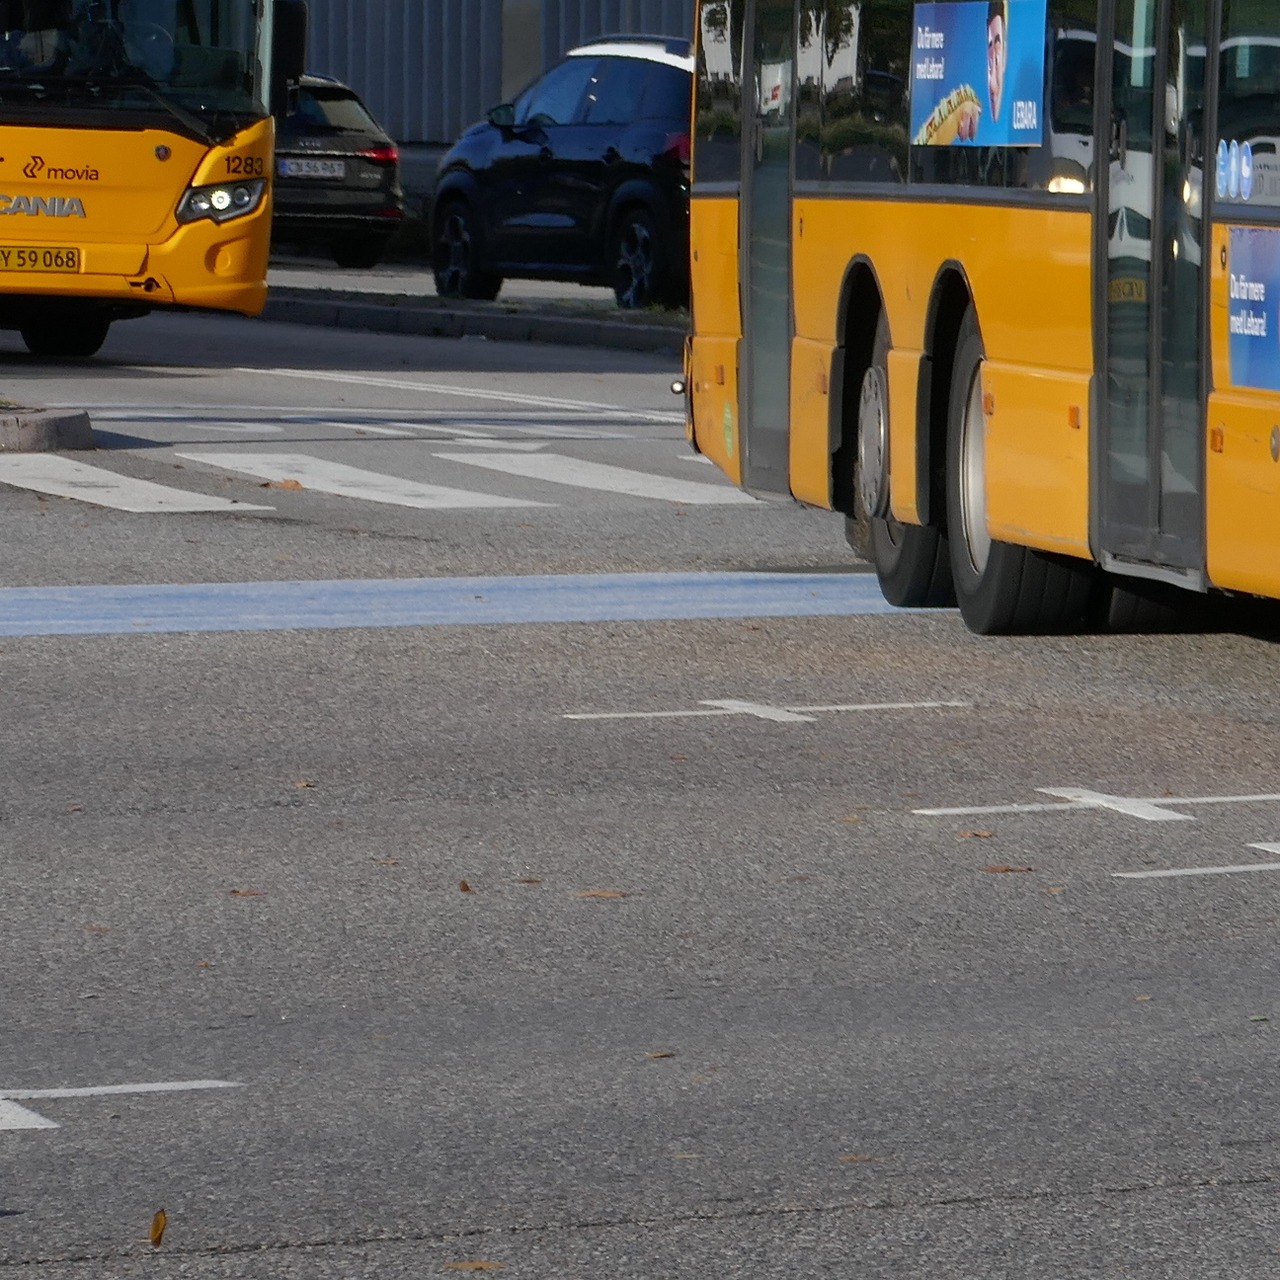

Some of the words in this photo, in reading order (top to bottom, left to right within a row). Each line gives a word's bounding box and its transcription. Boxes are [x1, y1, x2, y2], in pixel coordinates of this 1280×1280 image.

[1013, 100, 1037, 130] LEBARA
[47, 165, 99, 181] movia
[225, 156, 264, 177] 1283
[17, 250, 38, 268] 59
[43, 250, 76, 268] 068
